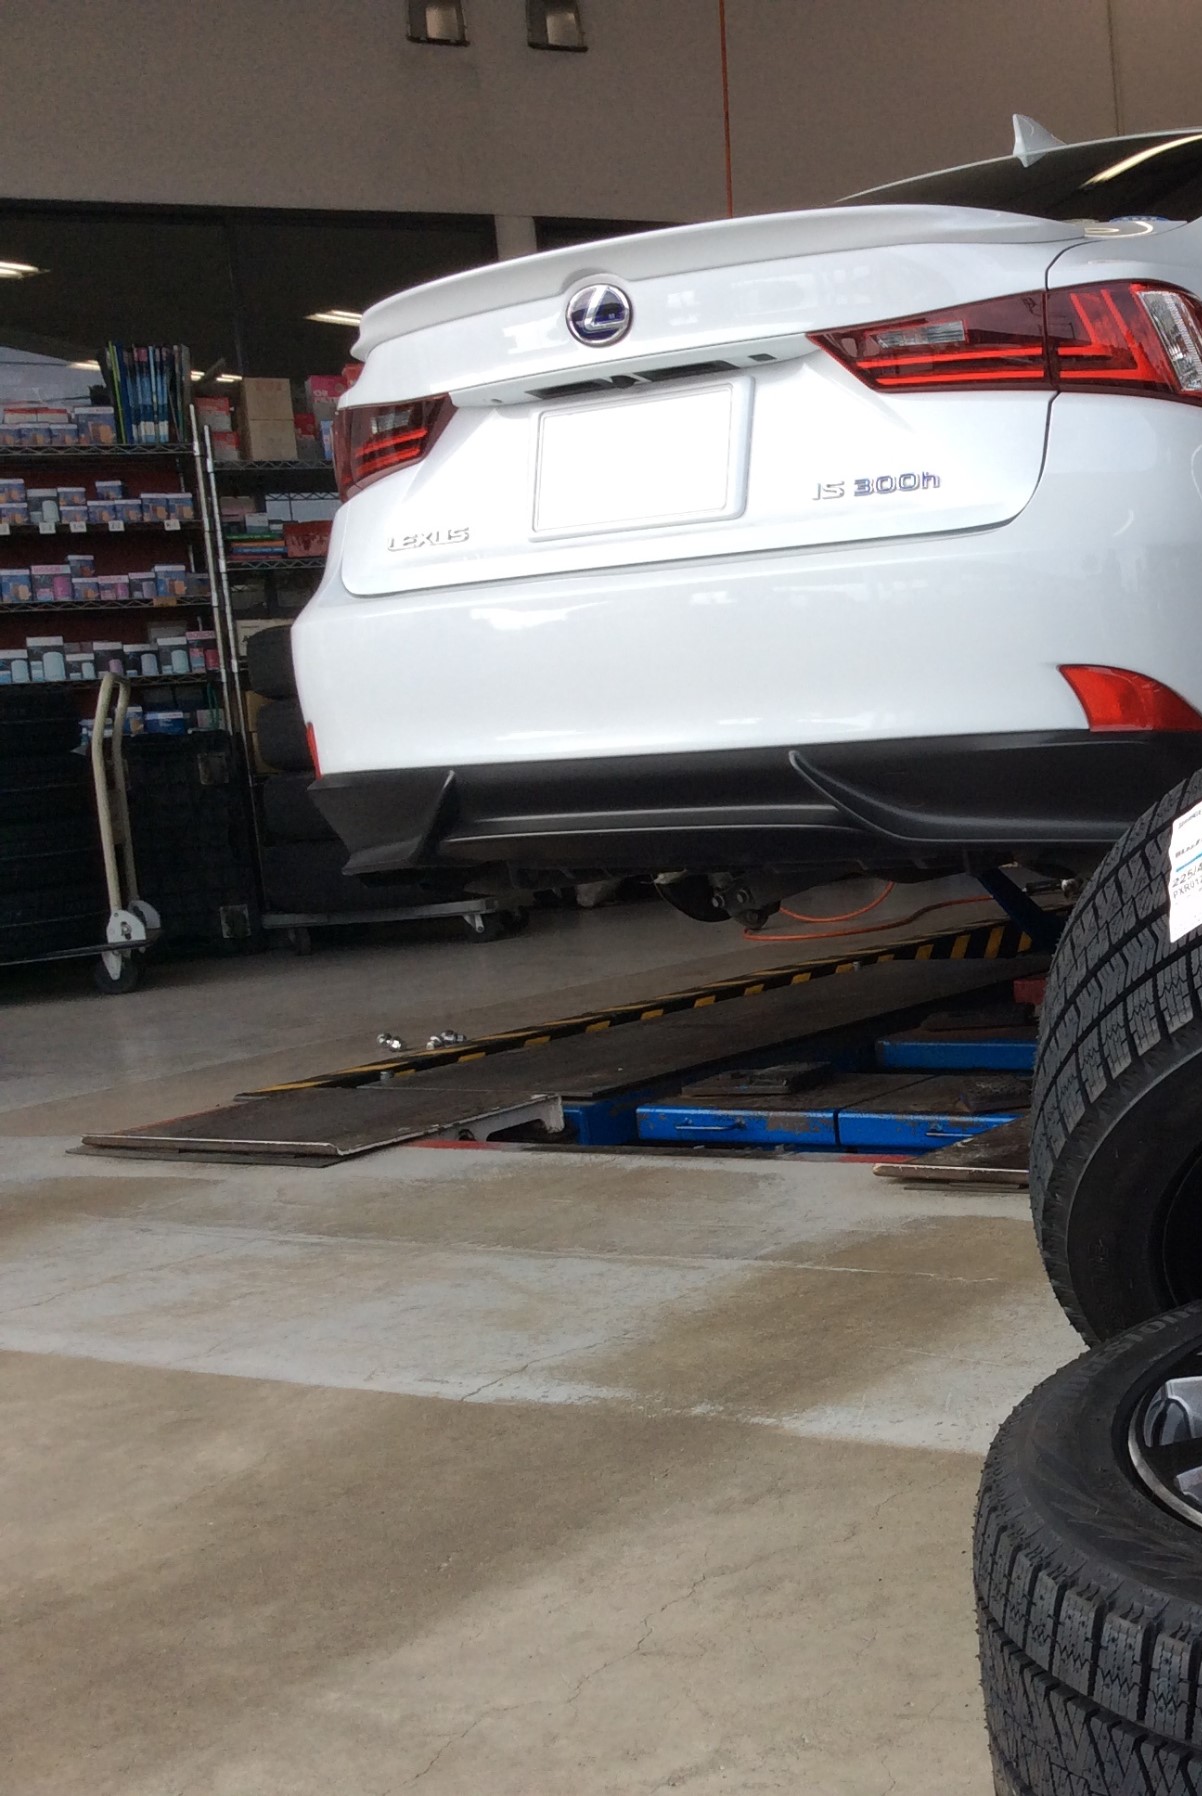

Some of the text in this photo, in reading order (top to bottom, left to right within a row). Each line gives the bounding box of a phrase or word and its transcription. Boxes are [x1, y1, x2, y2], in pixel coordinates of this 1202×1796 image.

[812, 471, 941, 501] IS 300h
[387, 526, 470, 552] LEXUS
